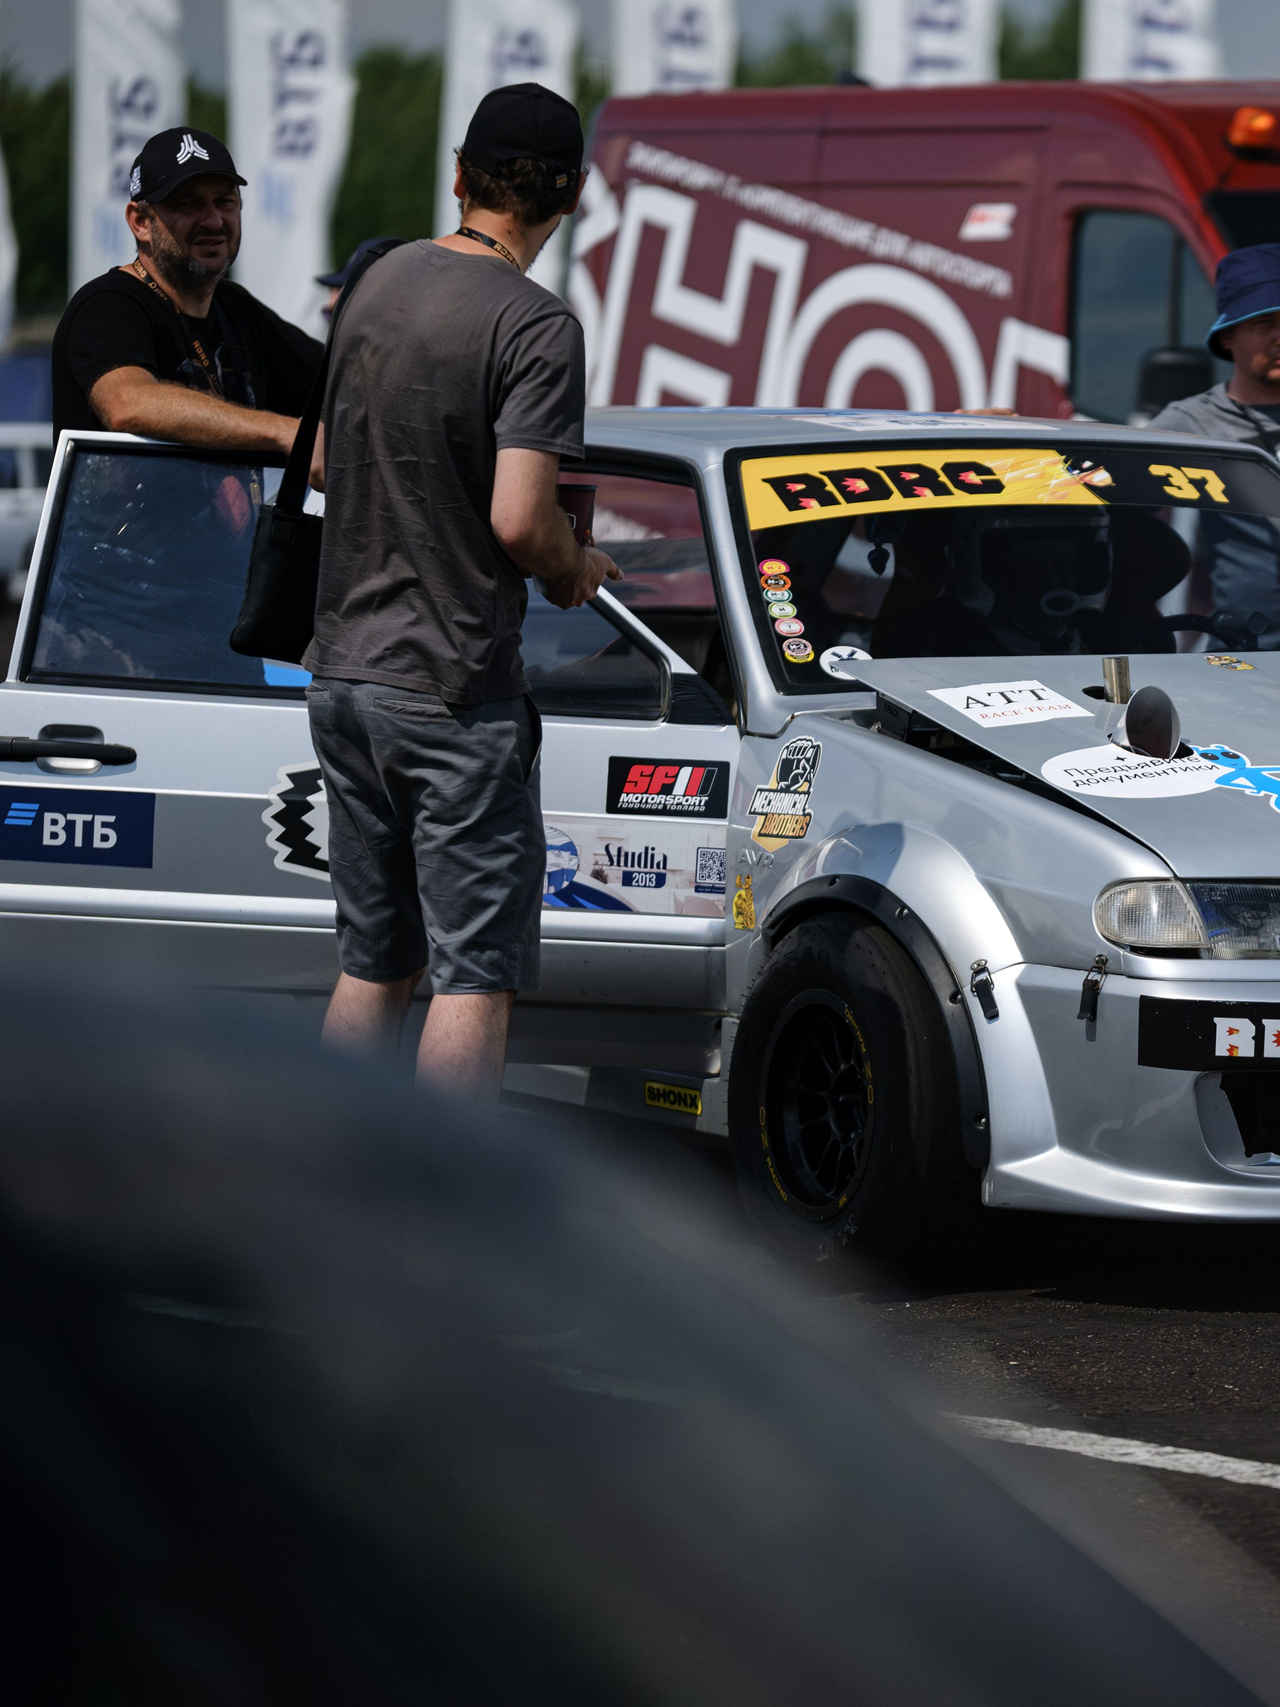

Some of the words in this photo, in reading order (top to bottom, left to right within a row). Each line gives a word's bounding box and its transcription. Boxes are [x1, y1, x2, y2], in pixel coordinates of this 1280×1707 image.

[269, 29, 327, 158] ВТБ
[761, 460, 1006, 512] RDRC
[1147, 463, 1230, 503] 37
[963, 687, 1050, 710] ATT
[979, 707, 1023, 719] RACE
[1023, 703, 1073, 714] TEAM
[1063, 755, 1201, 778] Предъявите
[1072, 764, 1220, 788] документики
[619, 793, 709, 806] MOTORSPORT
[751, 790, 809, 816] MECHANICAL
[42, 811, 118, 849] ВТБ
[760, 813, 811, 838] BROTHERS
[604, 843, 668, 871] Studia
[631, 872, 656, 887] 2013
[647, 1085, 699, 1110] SHONX
[766, 1156, 788, 1202] RACING
